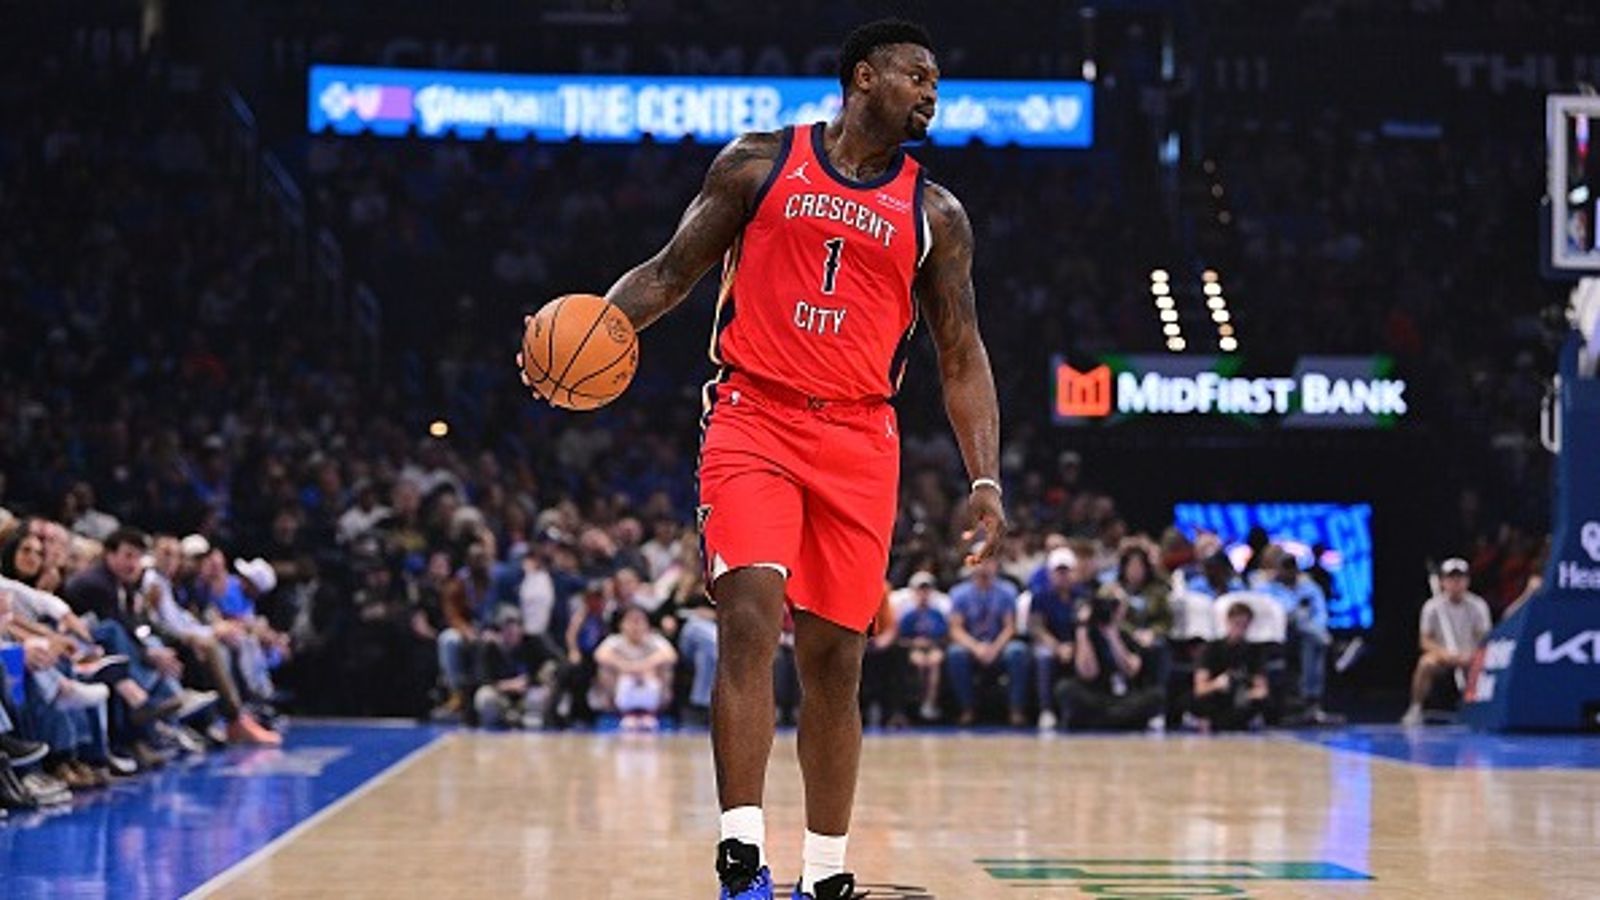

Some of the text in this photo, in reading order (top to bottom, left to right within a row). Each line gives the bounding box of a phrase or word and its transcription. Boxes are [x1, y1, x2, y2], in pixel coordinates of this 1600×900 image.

[561, 84, 632, 137] THE
[637, 85, 781, 137] CENTER
[785, 193, 896, 248] CRESCENT
[820, 237, 845, 296] 1
[793, 301, 847, 335] CITY
